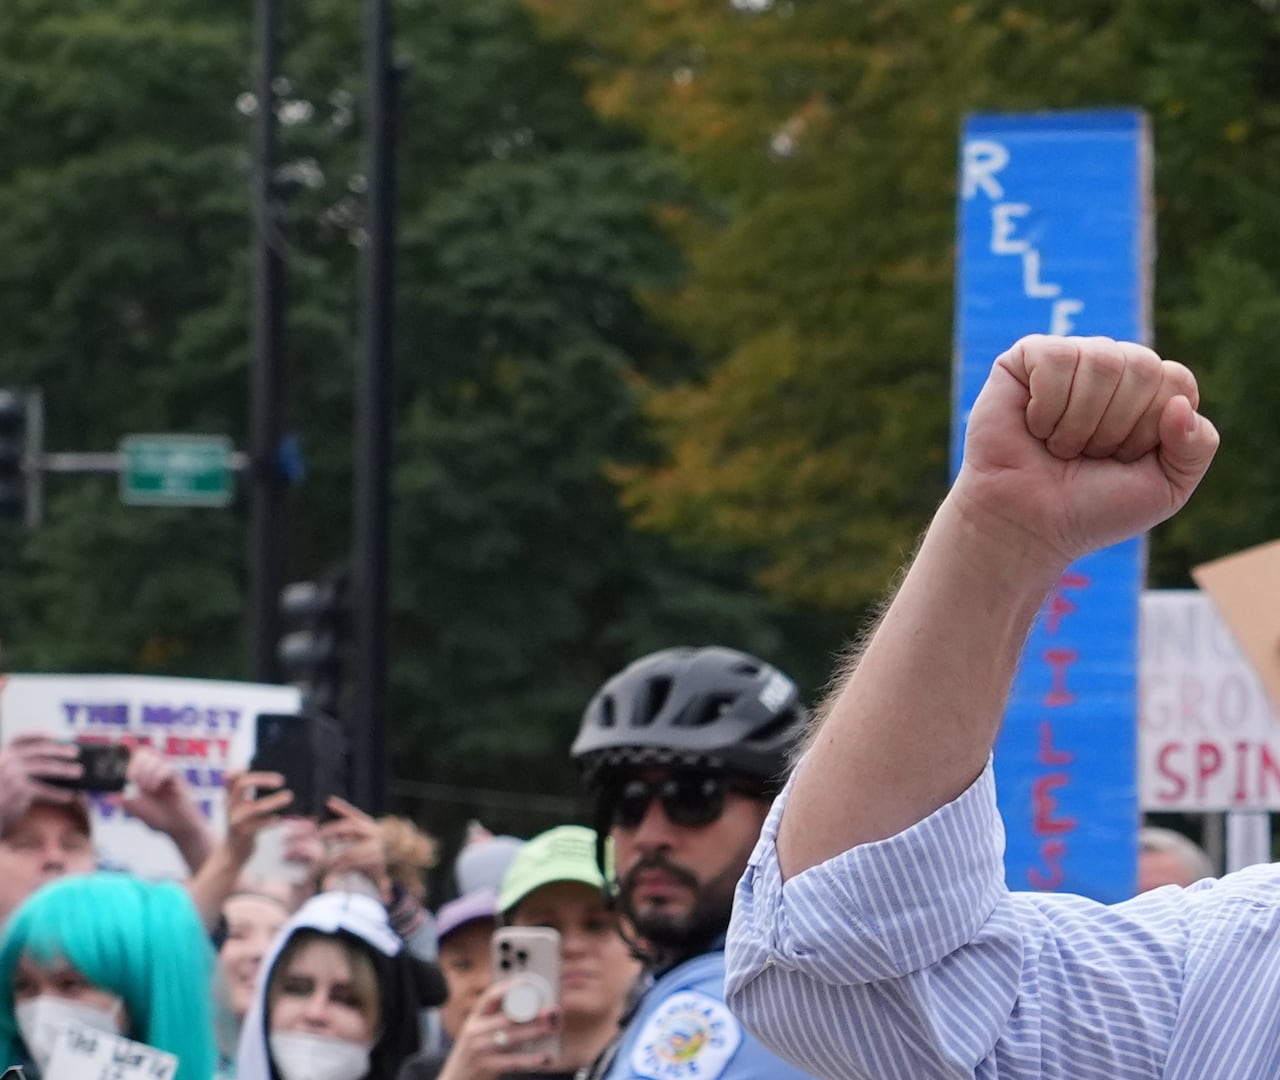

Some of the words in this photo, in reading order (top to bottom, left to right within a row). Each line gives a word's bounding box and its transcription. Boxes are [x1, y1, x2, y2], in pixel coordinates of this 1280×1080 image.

[961, 140, 1085, 336] RELE
[63, 704, 129, 725] THE
[142, 705, 242, 729] MOST
